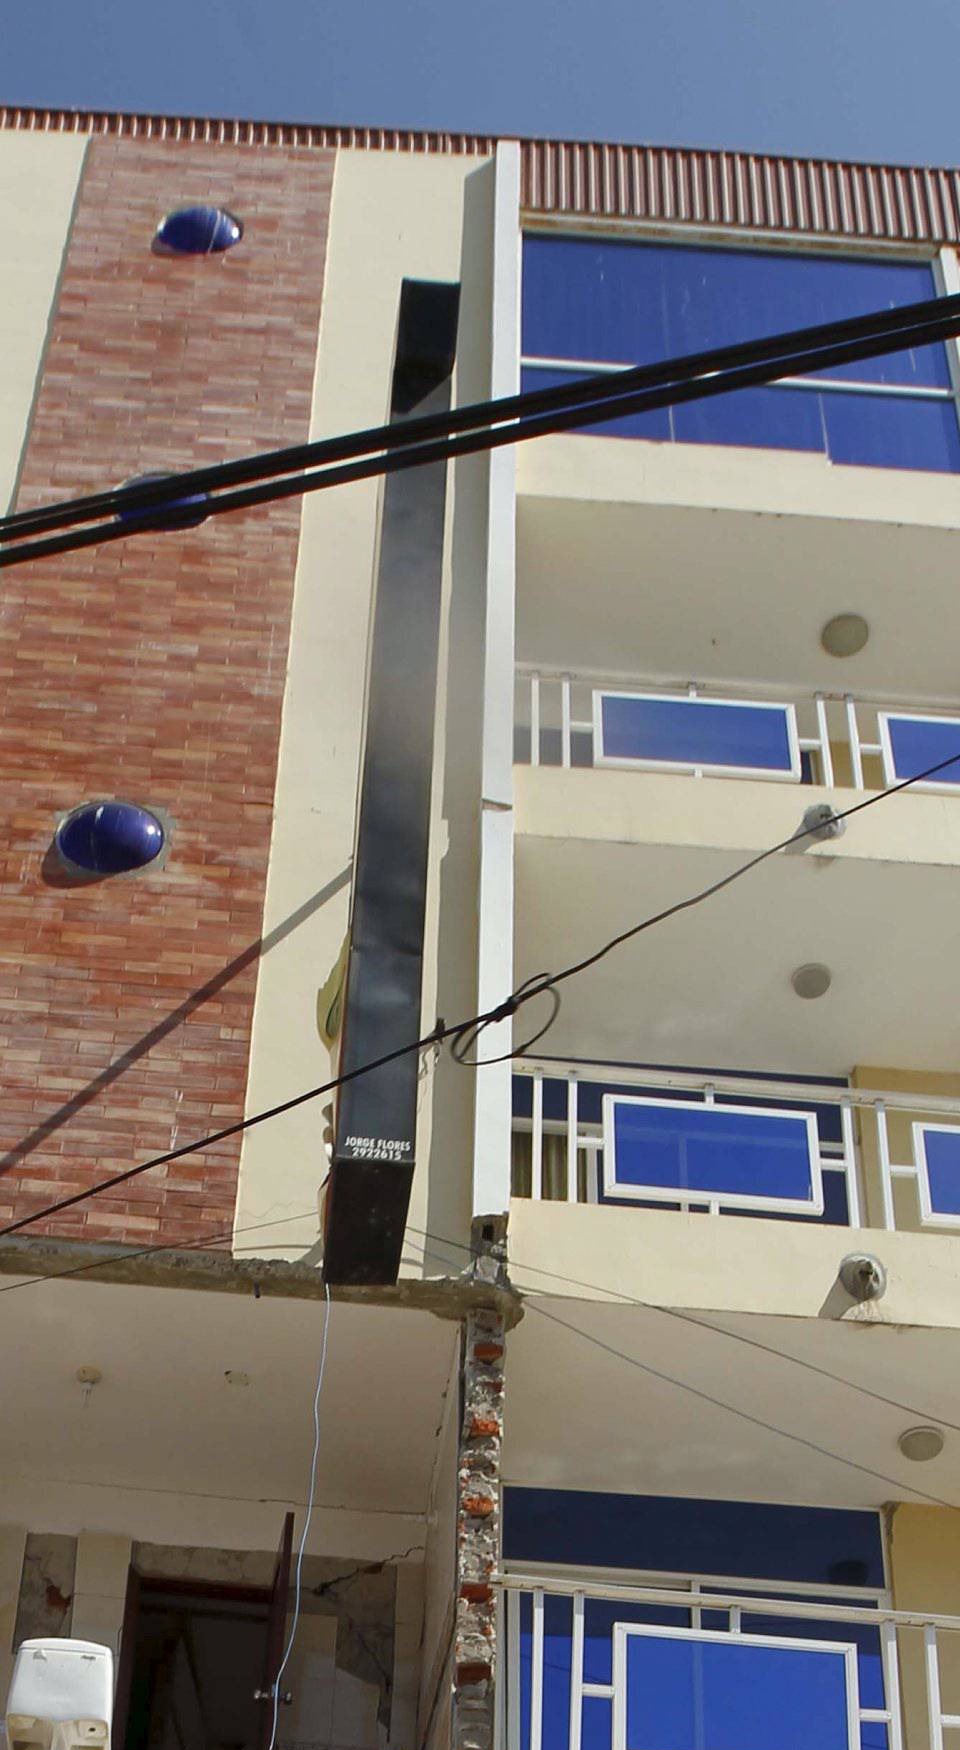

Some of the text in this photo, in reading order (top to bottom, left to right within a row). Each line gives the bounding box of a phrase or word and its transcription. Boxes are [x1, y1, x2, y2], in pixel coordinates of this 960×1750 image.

[345, 1136, 411, 1151] JORGE FLORES
[352, 1147, 402, 1160] 2922615
